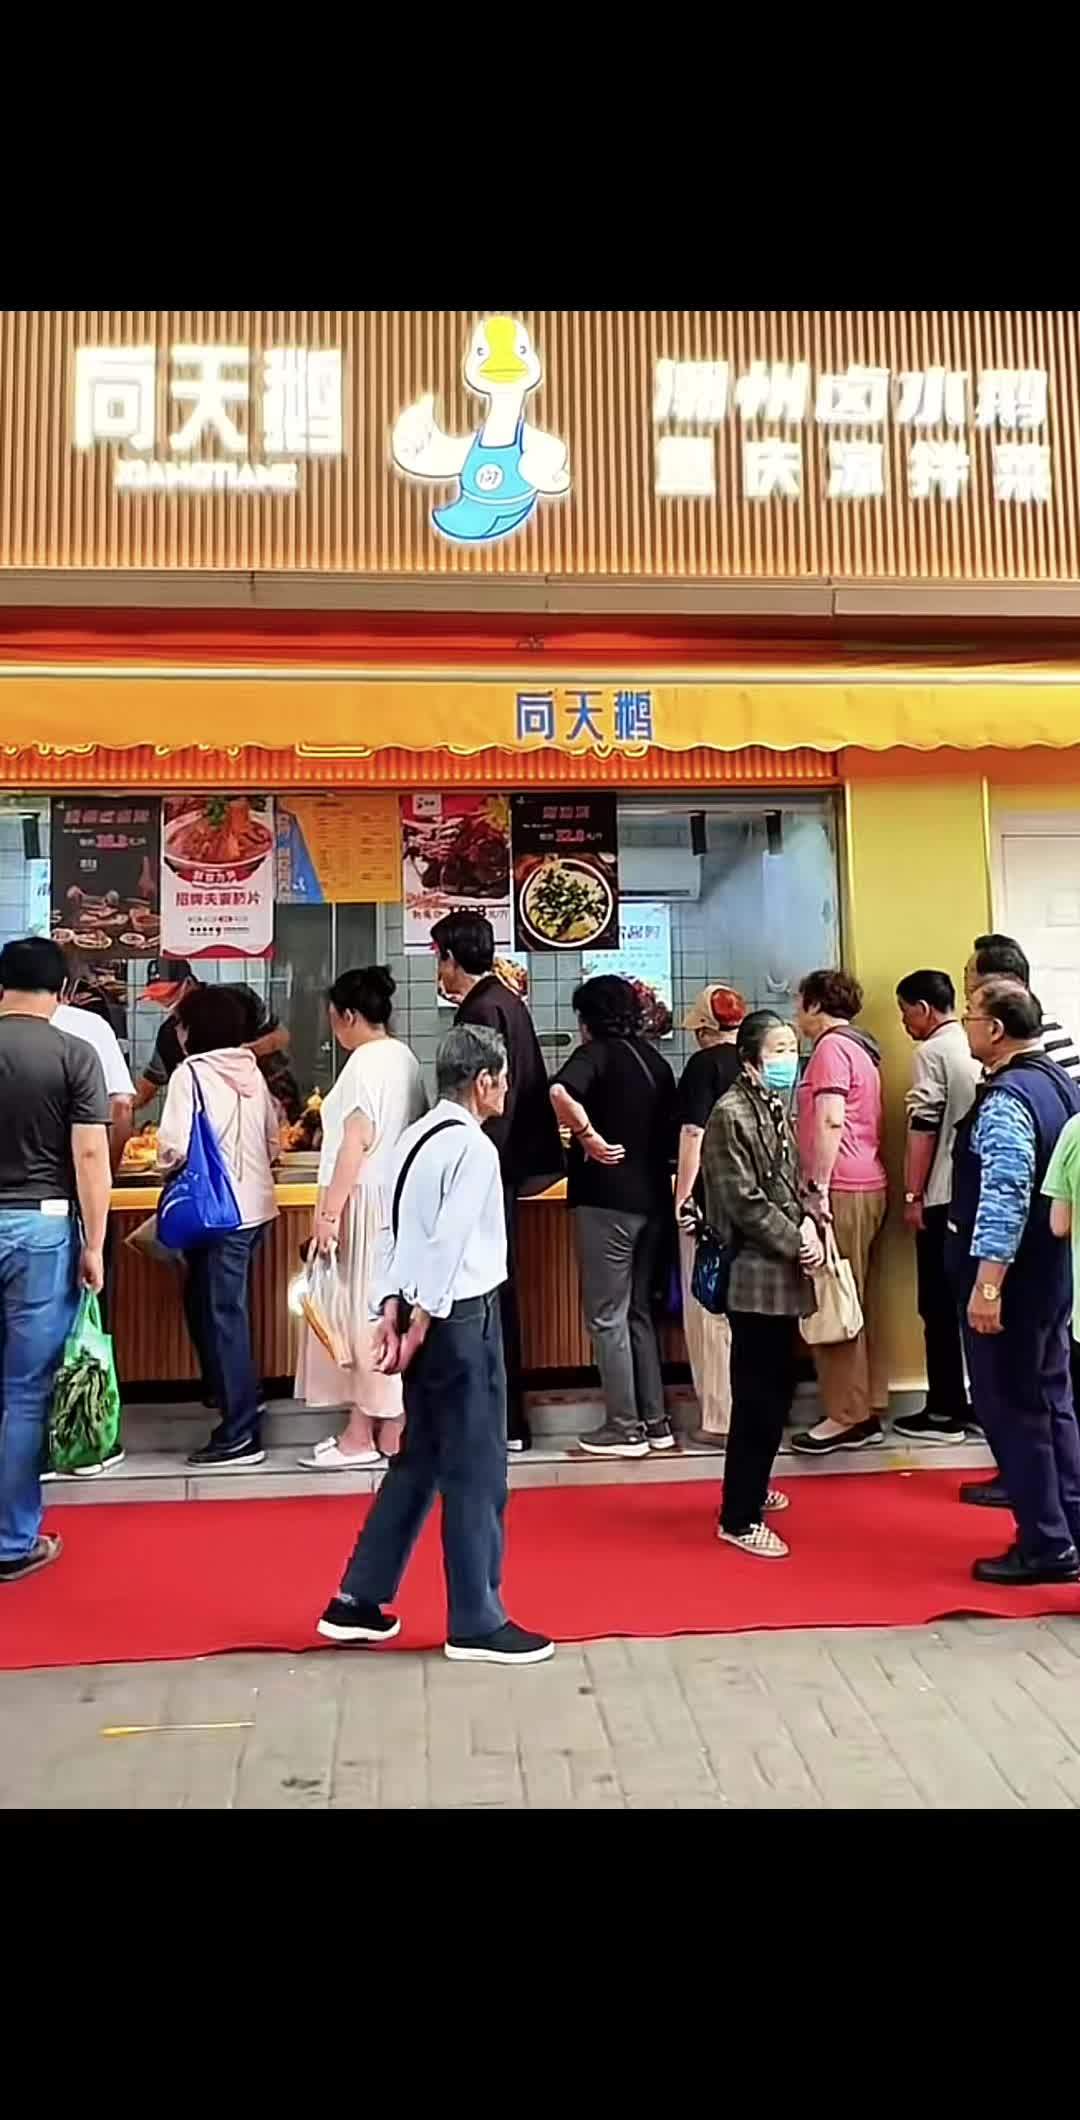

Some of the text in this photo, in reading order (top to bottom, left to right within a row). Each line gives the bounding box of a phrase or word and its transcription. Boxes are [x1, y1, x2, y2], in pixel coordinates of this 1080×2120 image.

[76, 346, 342, 453] 向天鹅
[515, 689, 653, 741] 向天鹅
